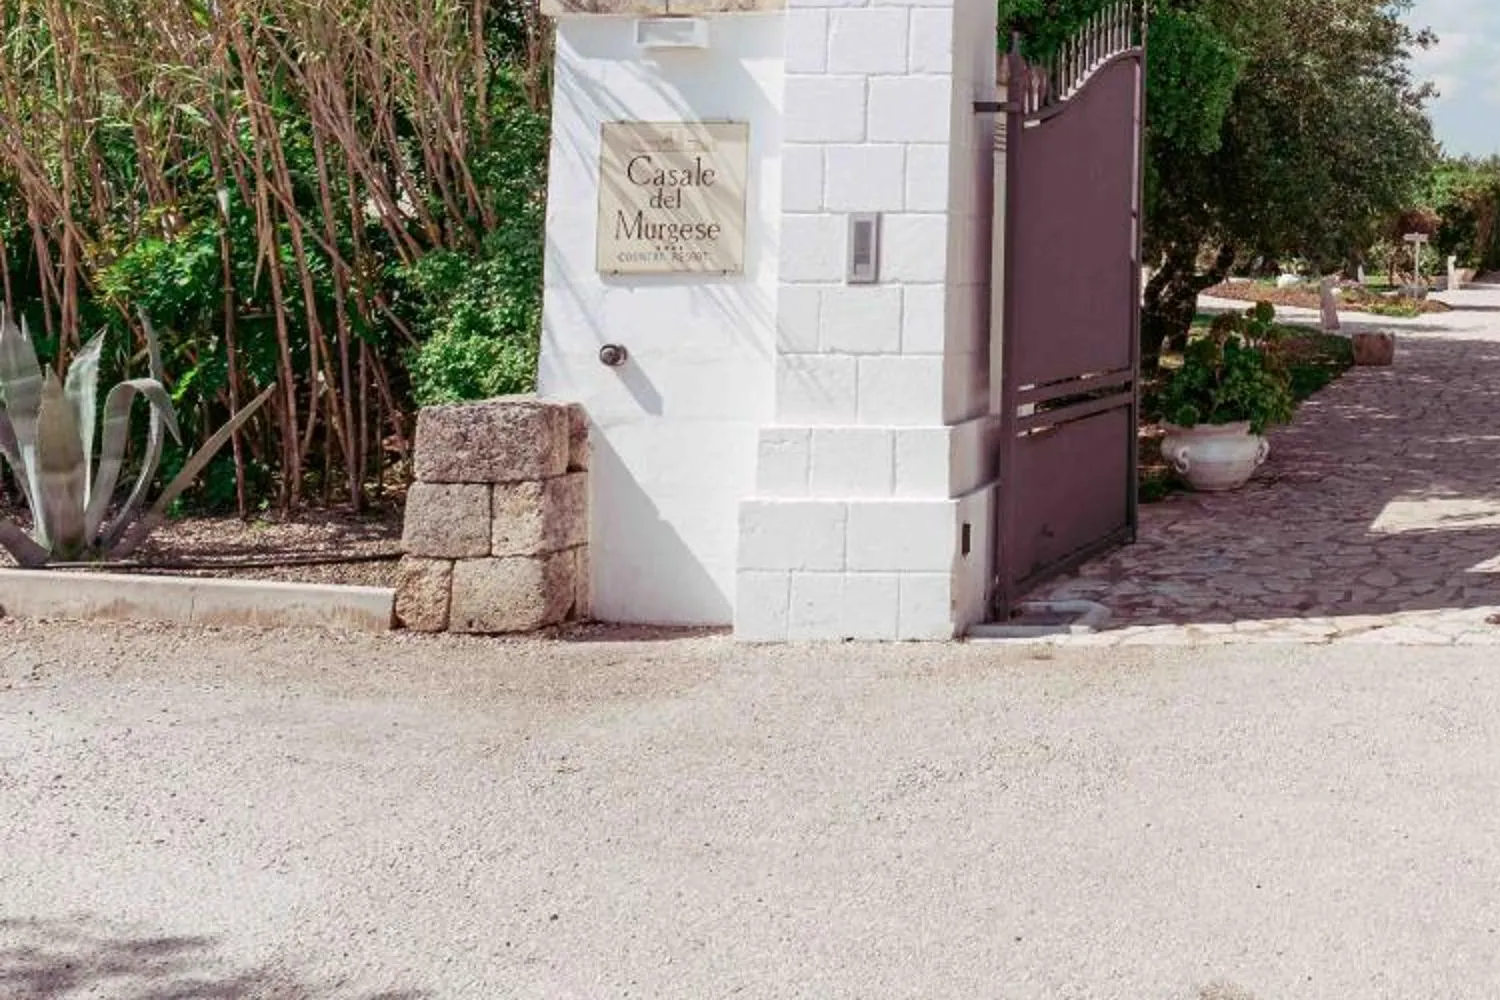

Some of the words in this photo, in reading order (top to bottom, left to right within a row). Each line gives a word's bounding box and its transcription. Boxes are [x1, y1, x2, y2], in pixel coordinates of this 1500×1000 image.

[627, 155, 716, 187] Casale
[649, 187, 682, 210] del
[614, 209, 722, 243] Murgese
